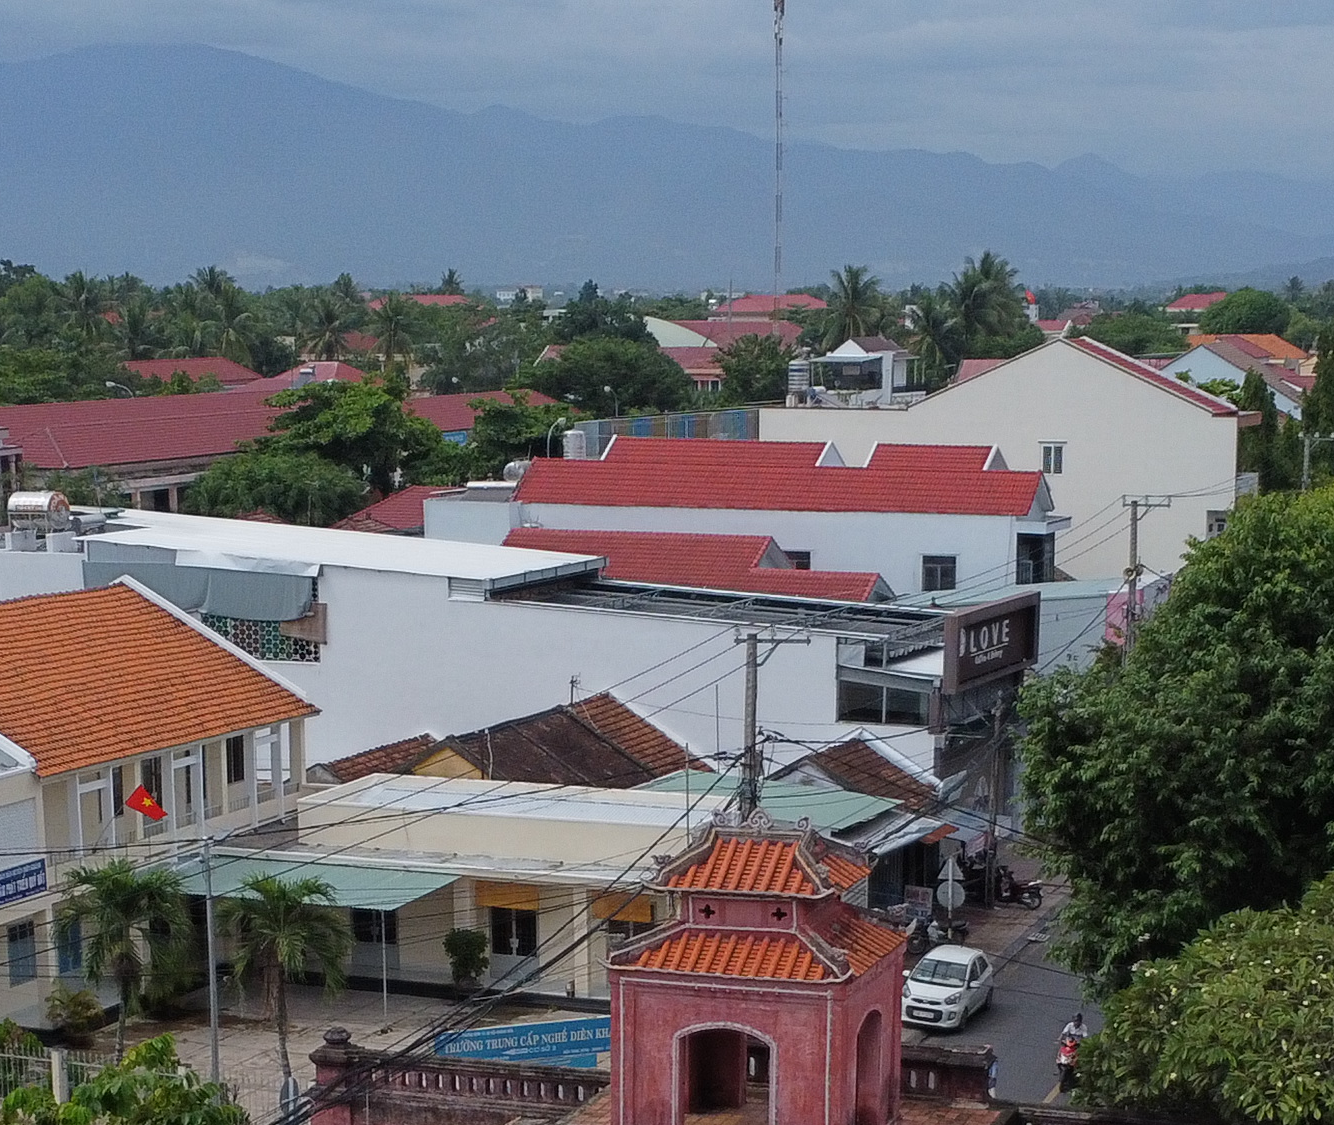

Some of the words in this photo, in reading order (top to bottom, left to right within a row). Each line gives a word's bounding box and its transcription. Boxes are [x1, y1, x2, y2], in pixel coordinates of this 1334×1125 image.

[970, 619, 1009, 652] LOVE
[486, 1037, 517, 1050] TRUNG
[519, 1031, 539, 1046] CẤP
